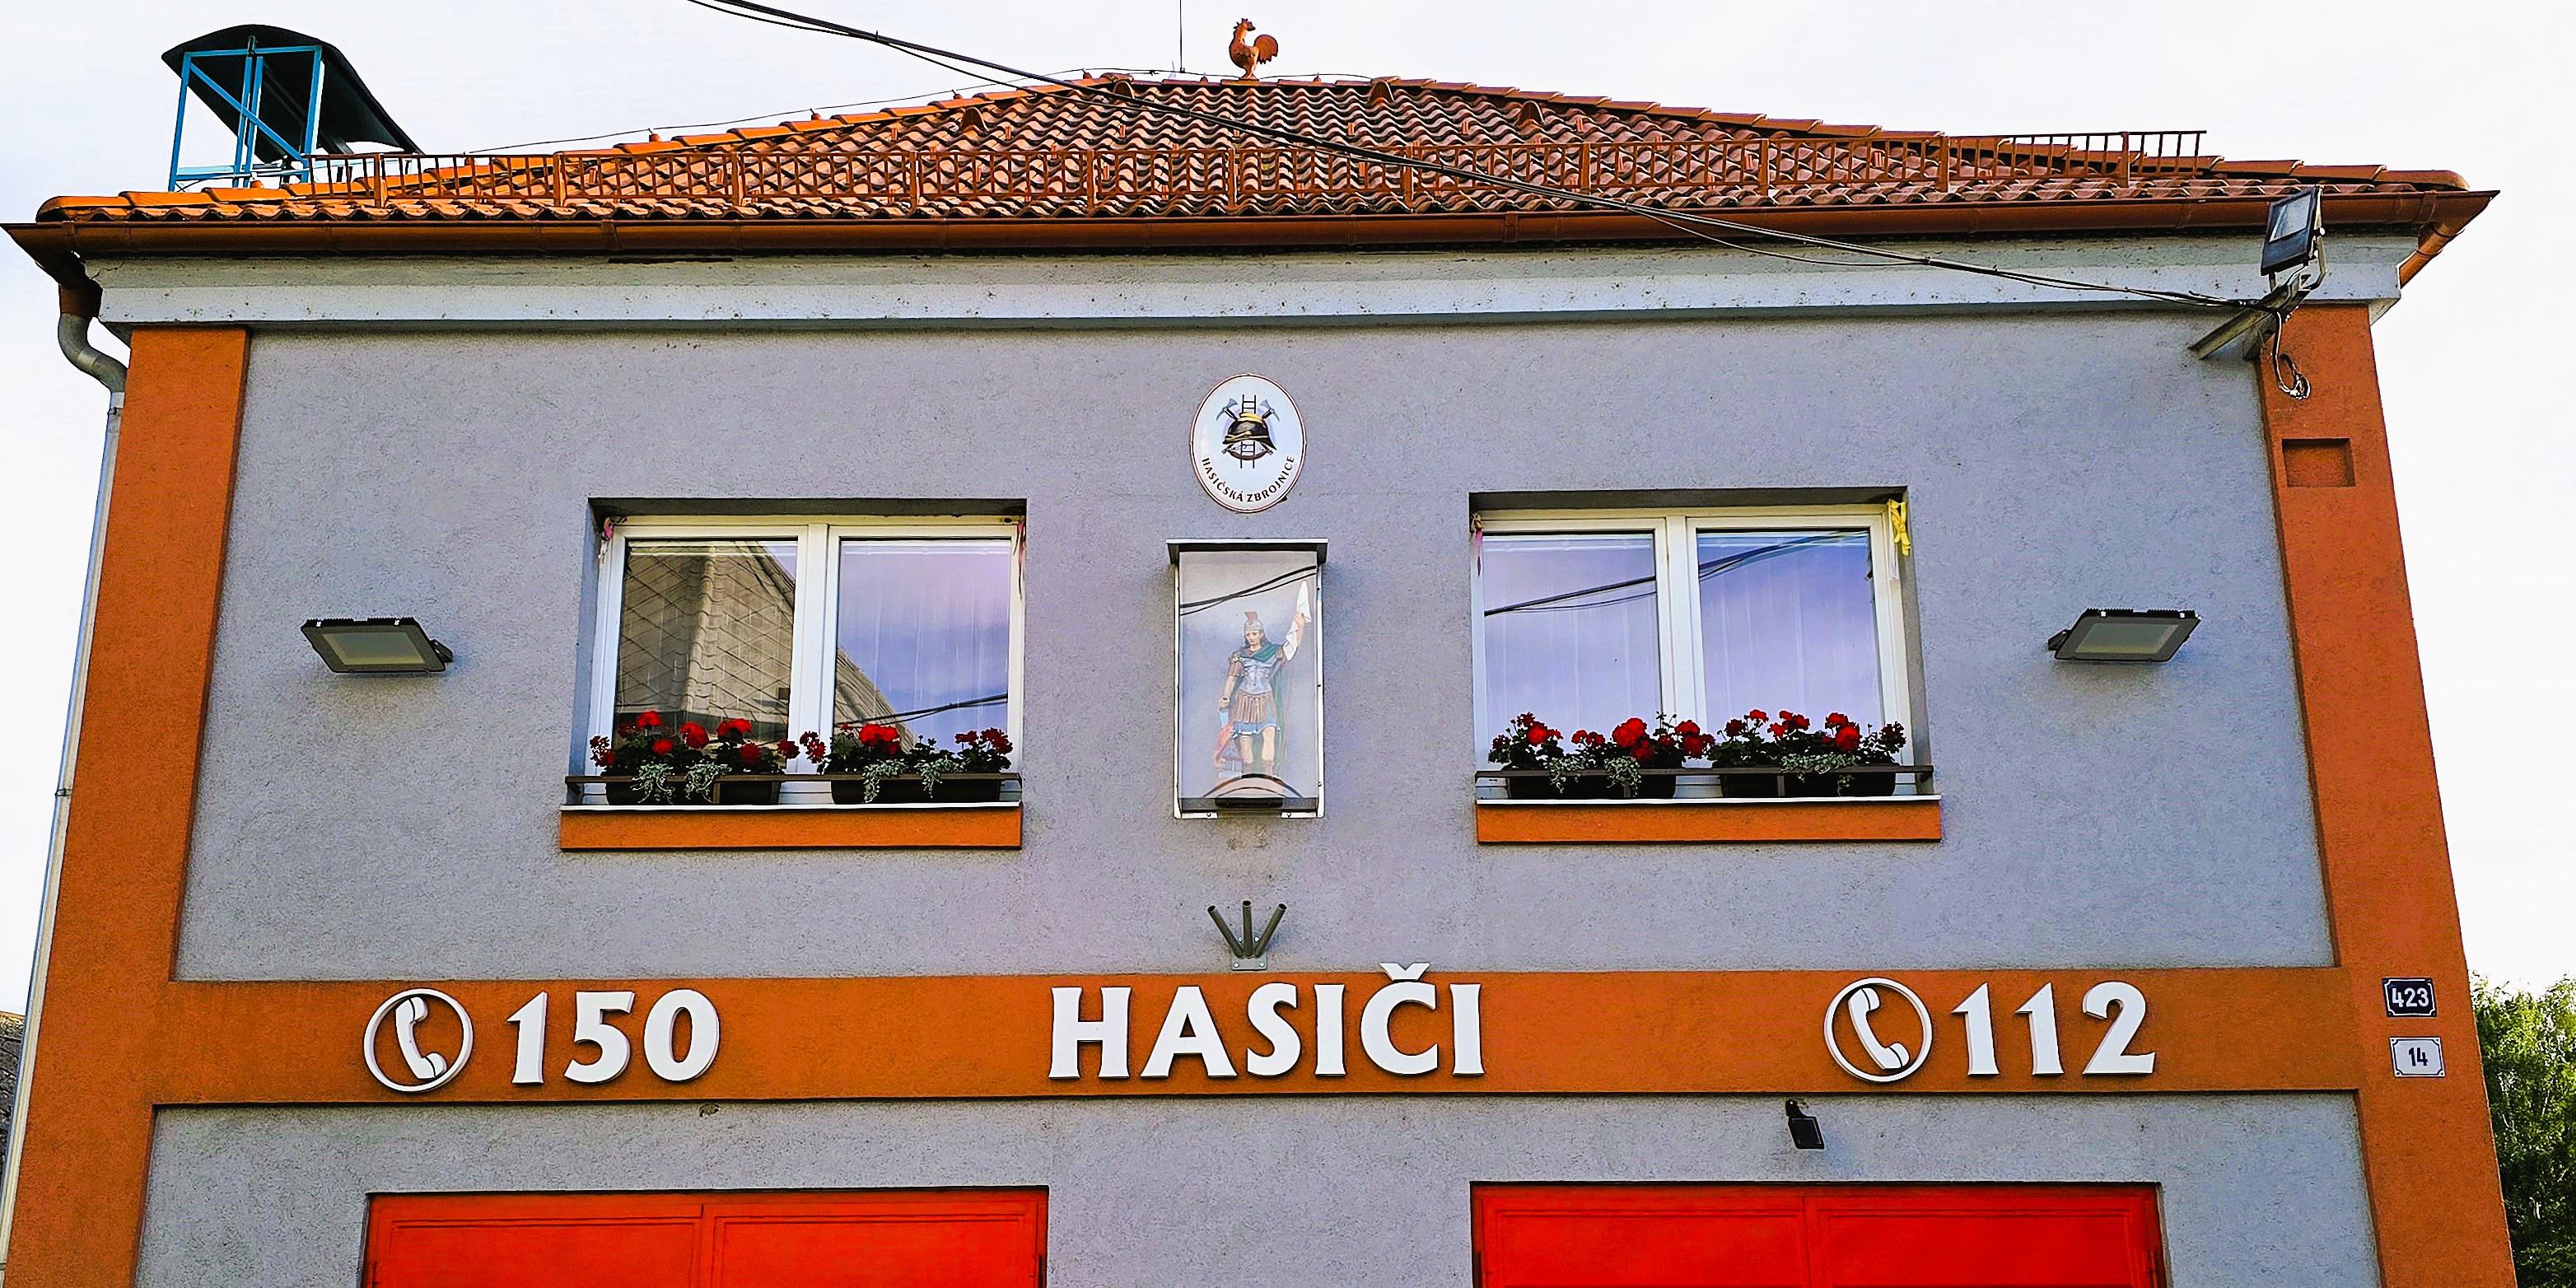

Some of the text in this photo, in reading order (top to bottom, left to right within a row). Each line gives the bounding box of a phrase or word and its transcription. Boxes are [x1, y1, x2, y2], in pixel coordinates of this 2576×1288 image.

[1202, 455, 1295, 502] HASIČSKÁ ZBROJNICE
[1048, 962, 1485, 1080] HASIČI
[1951, 981, 2156, 1076] 112
[2392, 987, 2429, 1007] 423
[506, 988, 720, 1084] 150
[2408, 1047, 2429, 1066] 14
